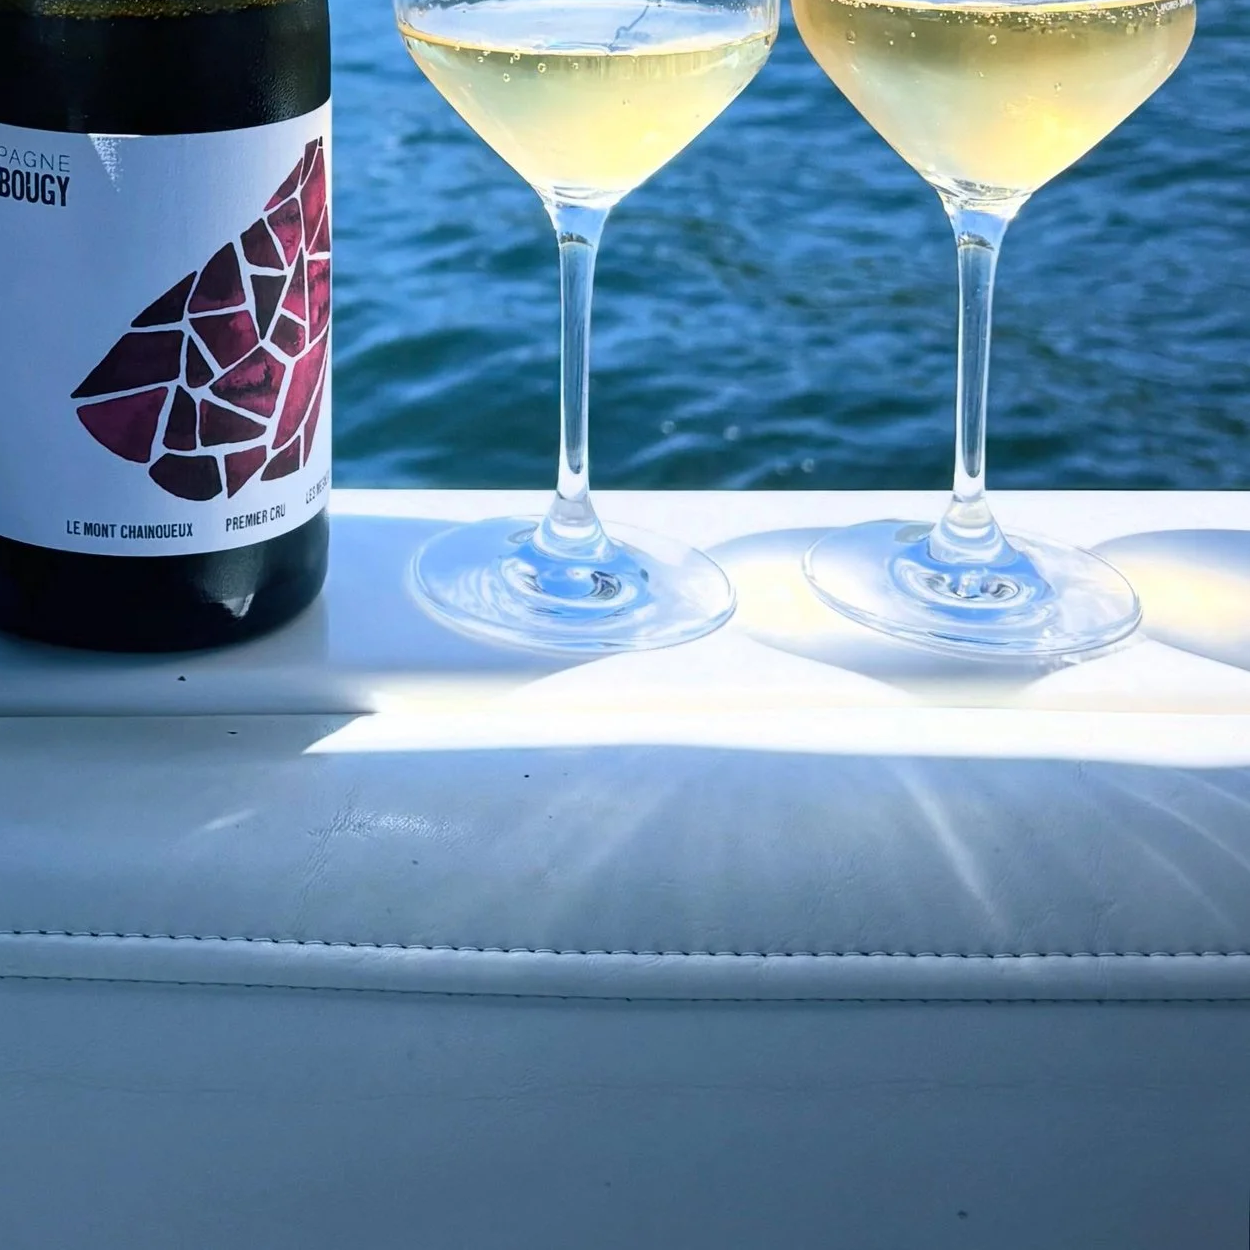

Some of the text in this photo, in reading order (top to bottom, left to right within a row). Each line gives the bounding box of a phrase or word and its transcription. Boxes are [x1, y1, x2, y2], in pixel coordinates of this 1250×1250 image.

[66, 520, 81, 535] LE
[83, 523, 117, 538] MONT
[226, 504, 286, 532] PREMIER CRU
